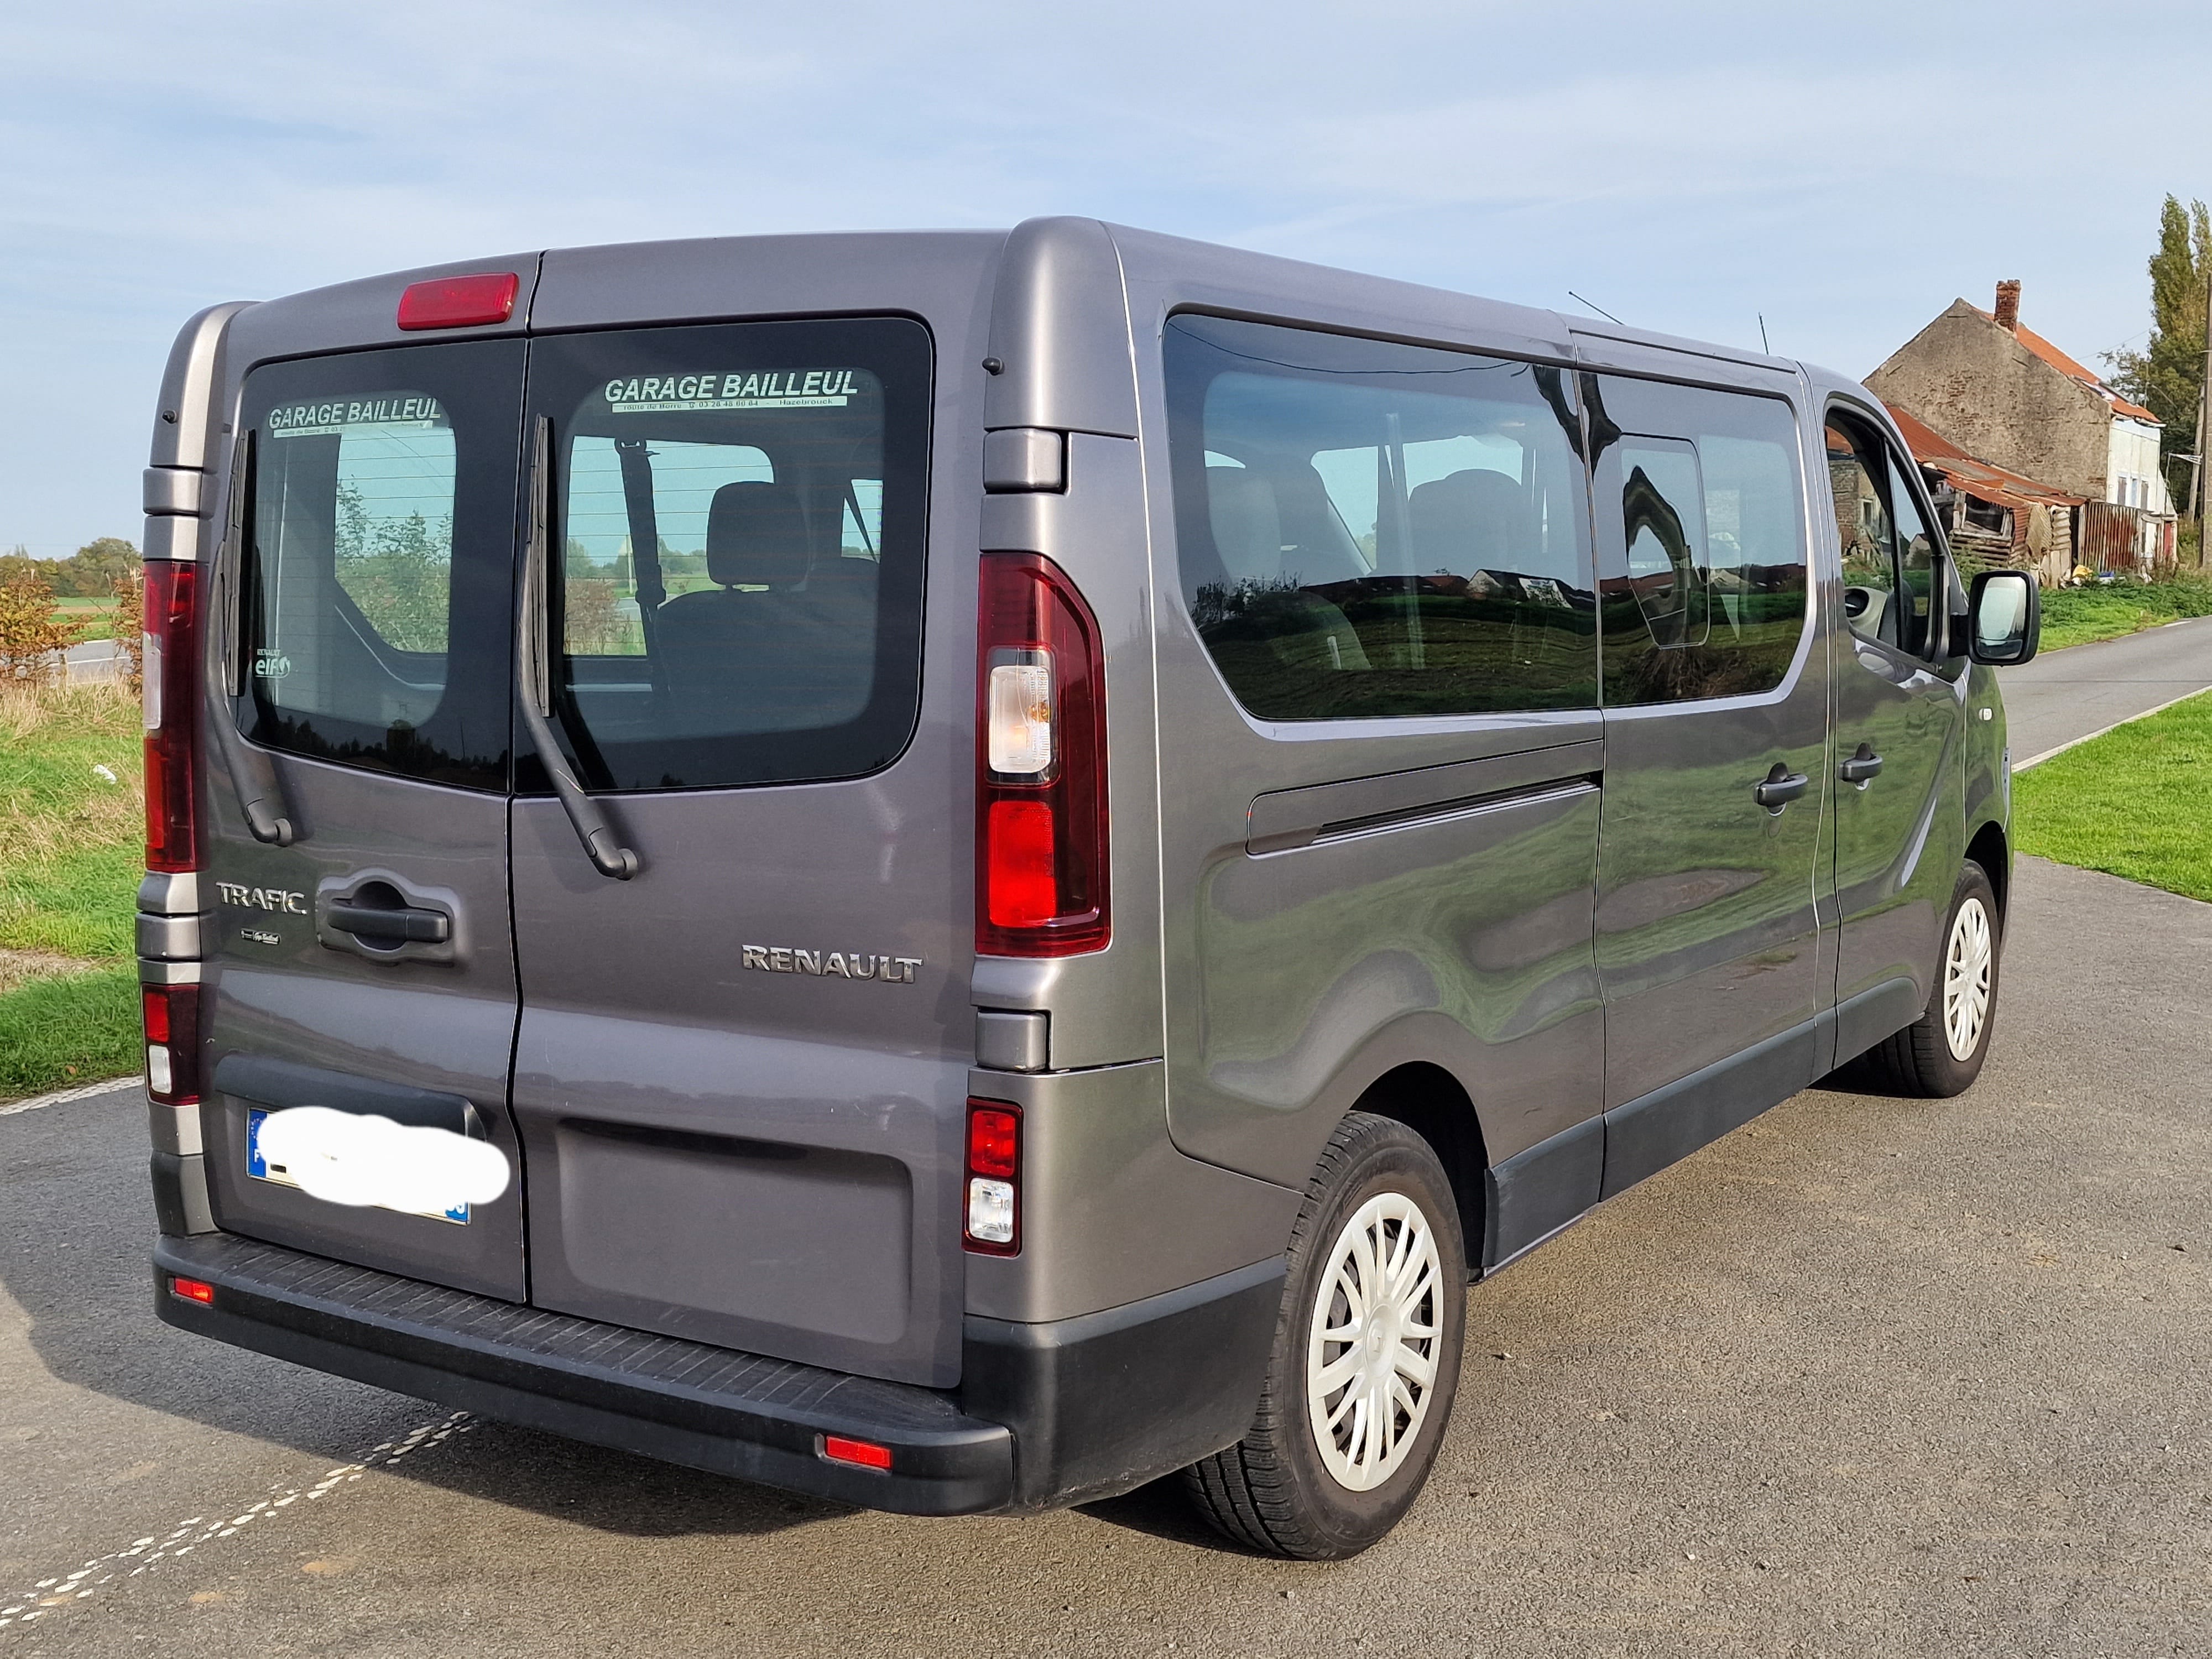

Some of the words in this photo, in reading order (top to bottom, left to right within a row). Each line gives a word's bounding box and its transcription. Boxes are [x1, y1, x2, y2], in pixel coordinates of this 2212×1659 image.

[605, 375, 717, 401] GARAGE
[721, 371, 858, 398] BAILLEUL
[269, 404, 344, 429] GARAGE
[347, 398, 441, 422] BAILLEUL
[255, 658, 278, 675] elf
[215, 881, 307, 915] TRAFIC
[742, 944, 924, 983] RENAULT
